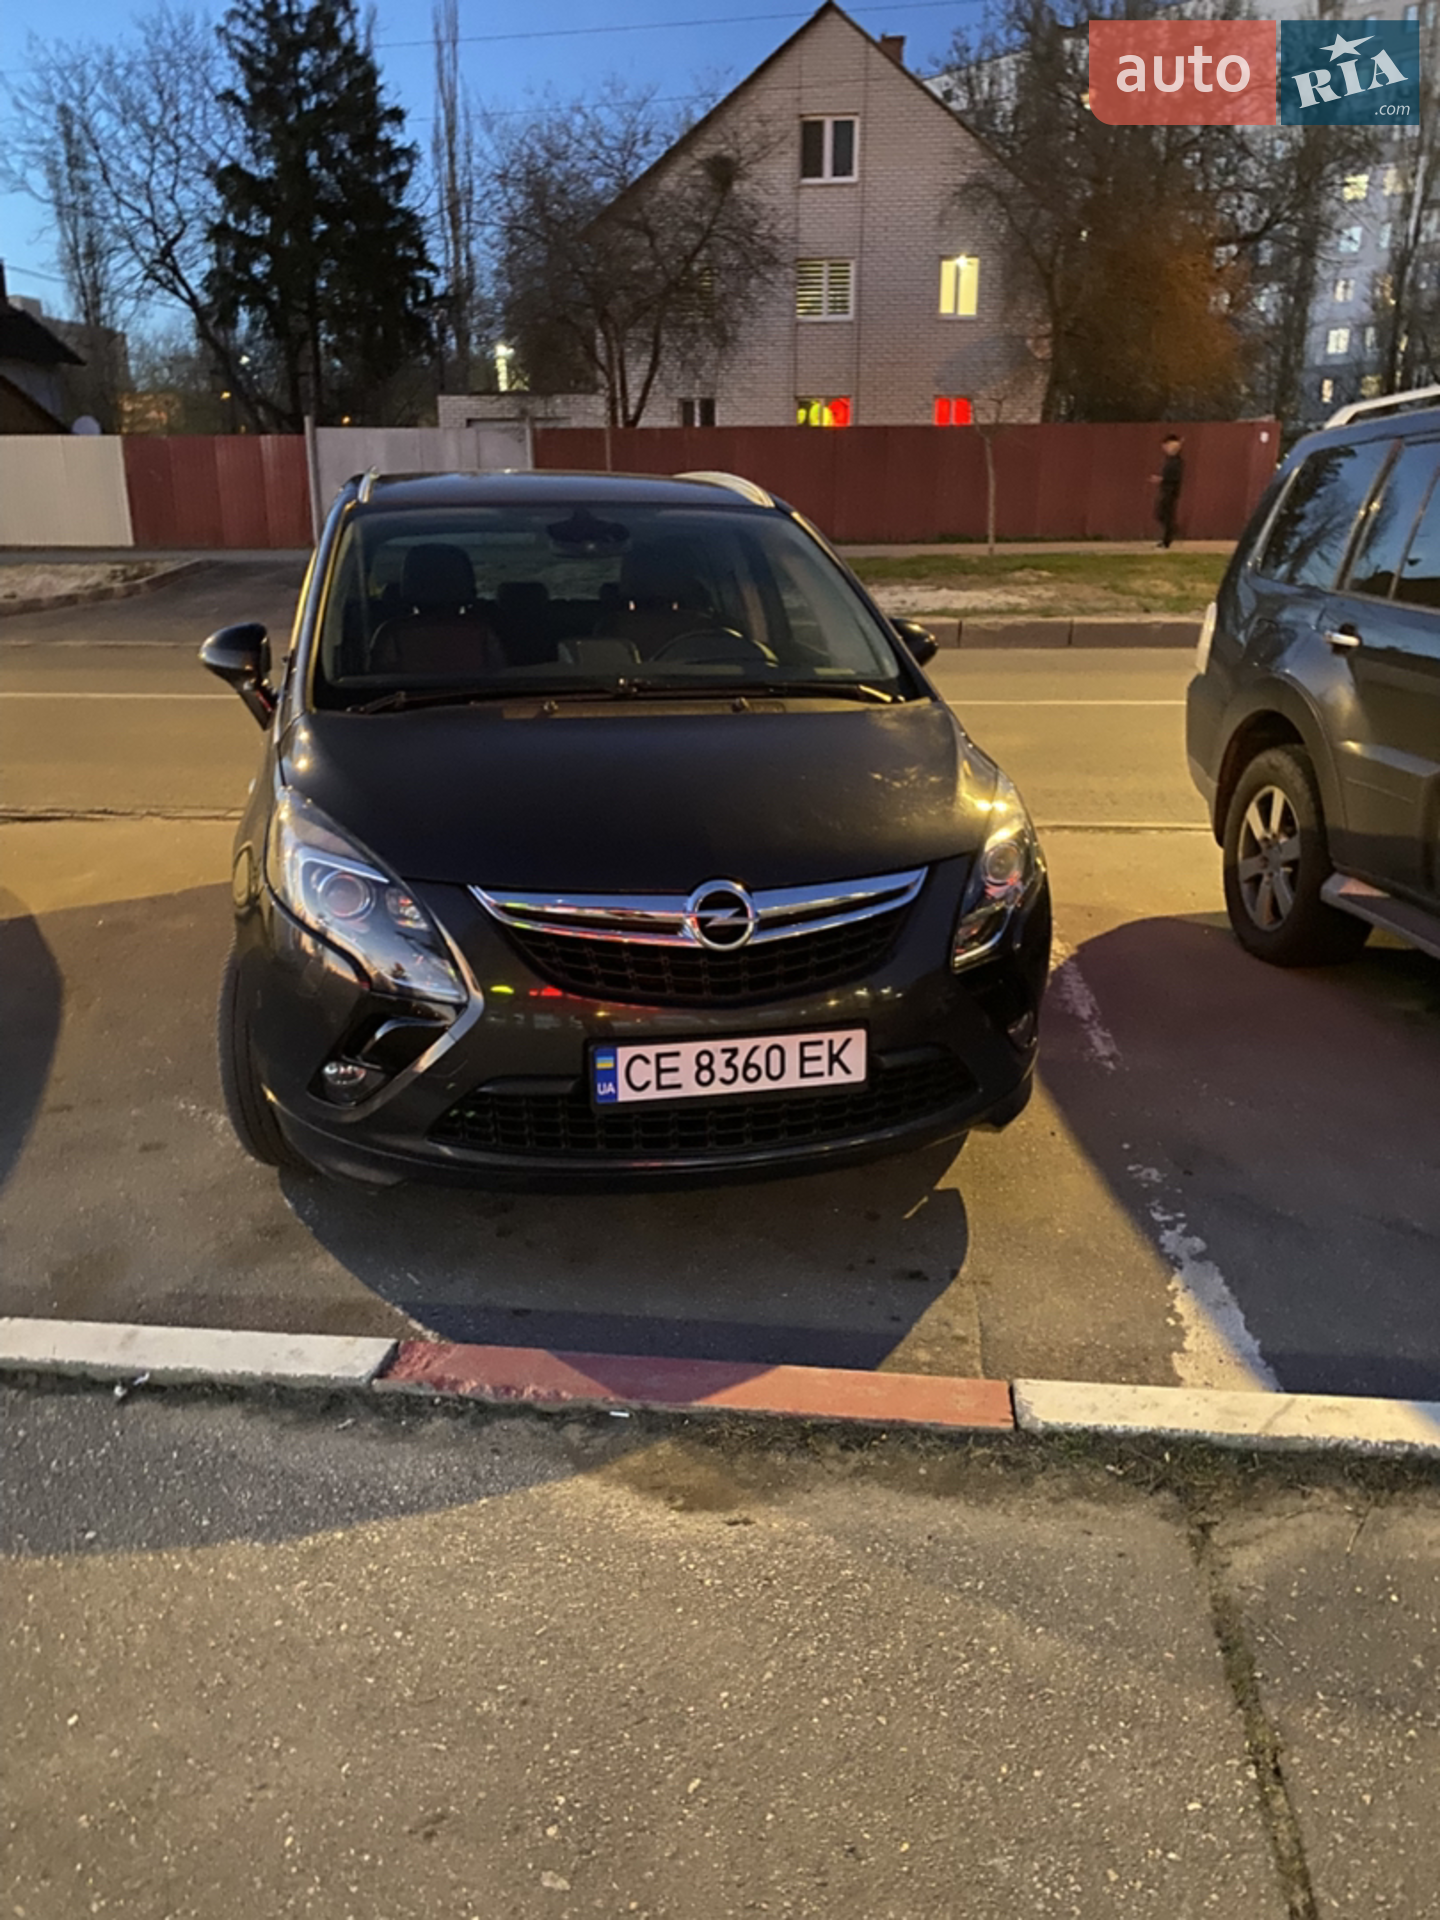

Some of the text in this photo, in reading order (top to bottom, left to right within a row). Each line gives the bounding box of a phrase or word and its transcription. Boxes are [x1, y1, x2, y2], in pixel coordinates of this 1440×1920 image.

[624, 1037, 852, 1092] CE 8360 EK
[597, 1081, 616, 1095] UA
